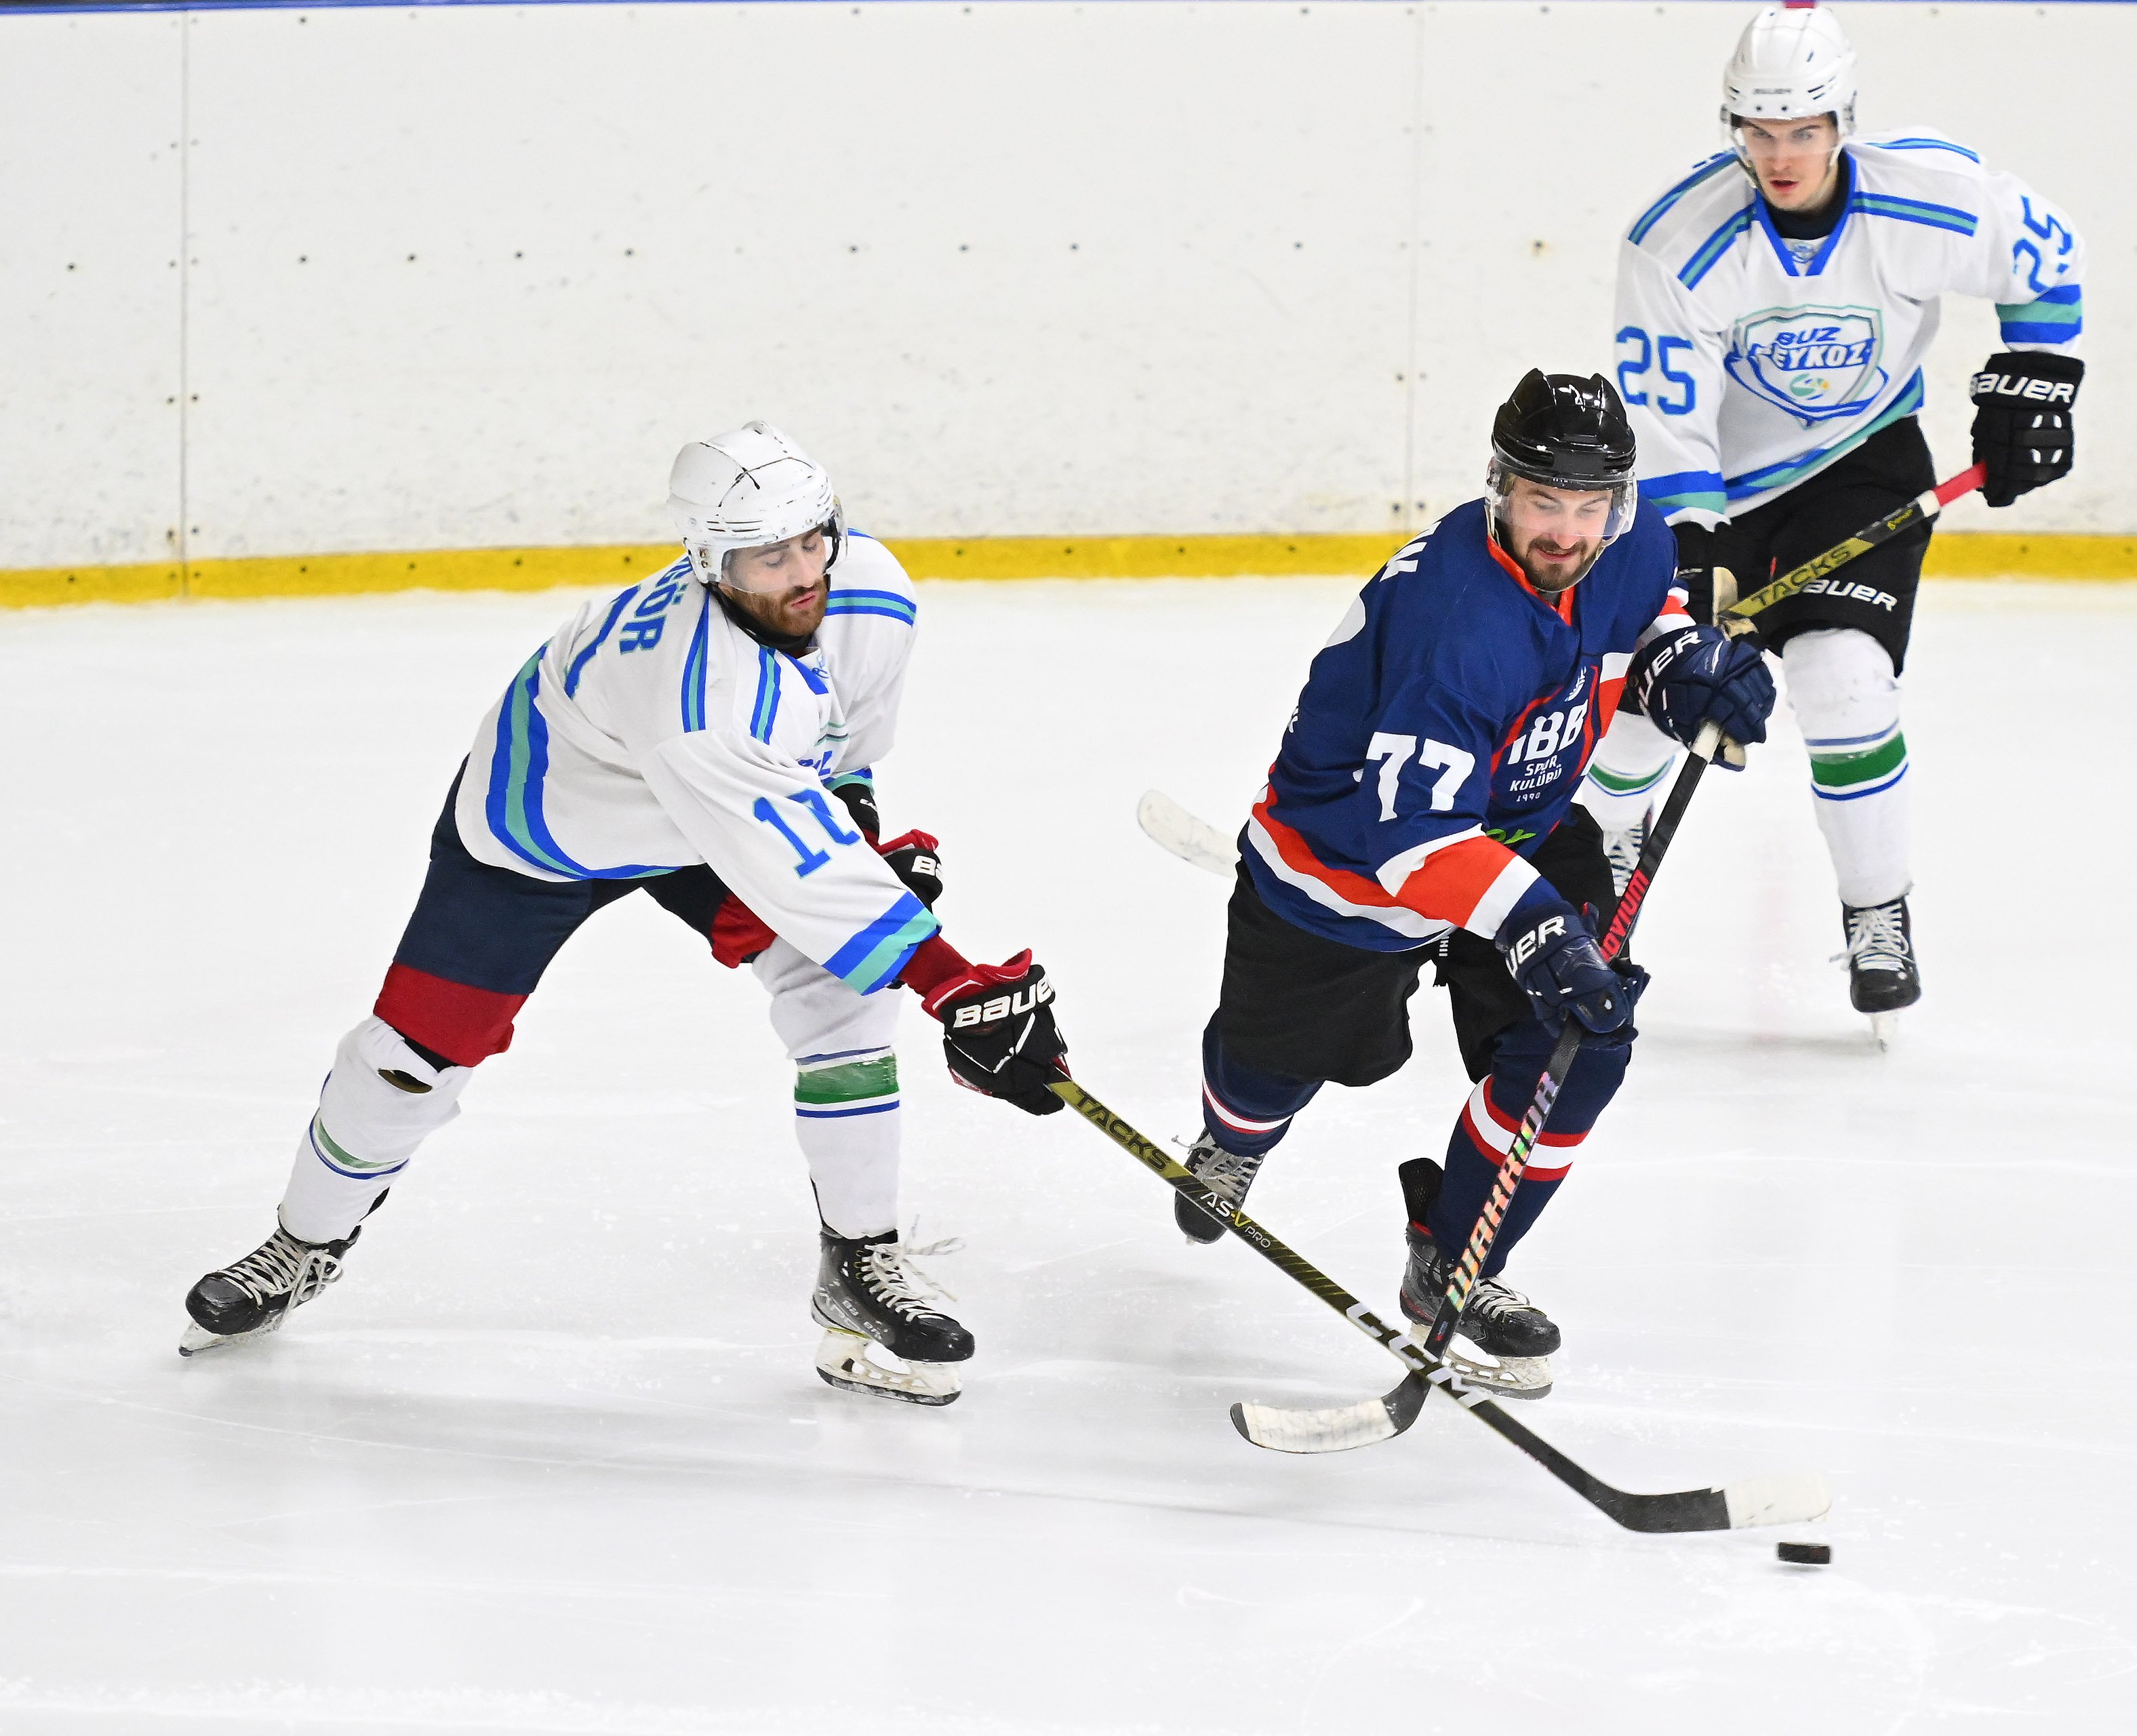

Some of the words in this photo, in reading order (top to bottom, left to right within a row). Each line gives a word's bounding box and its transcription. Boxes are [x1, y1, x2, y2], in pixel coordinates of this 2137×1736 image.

[2012, 195, 2073, 294] 25
[1616, 325, 1696, 416] 25
[1776, 327, 1841, 345] BUZ
[1750, 546, 1851, 605] TACKS
[1802, 578, 1898, 612] AUER
[1365, 731, 1476, 823] 77
[1516, 792, 1541, 803] 1990
[953, 974, 1054, 1029] BAUE
[1075, 1085, 1172, 1172] TACKS
[1447, 1071, 1561, 1313] WARRIOR
[1244, 1226, 1271, 1249] PRO
[1345, 1302, 1490, 1409] CCM
